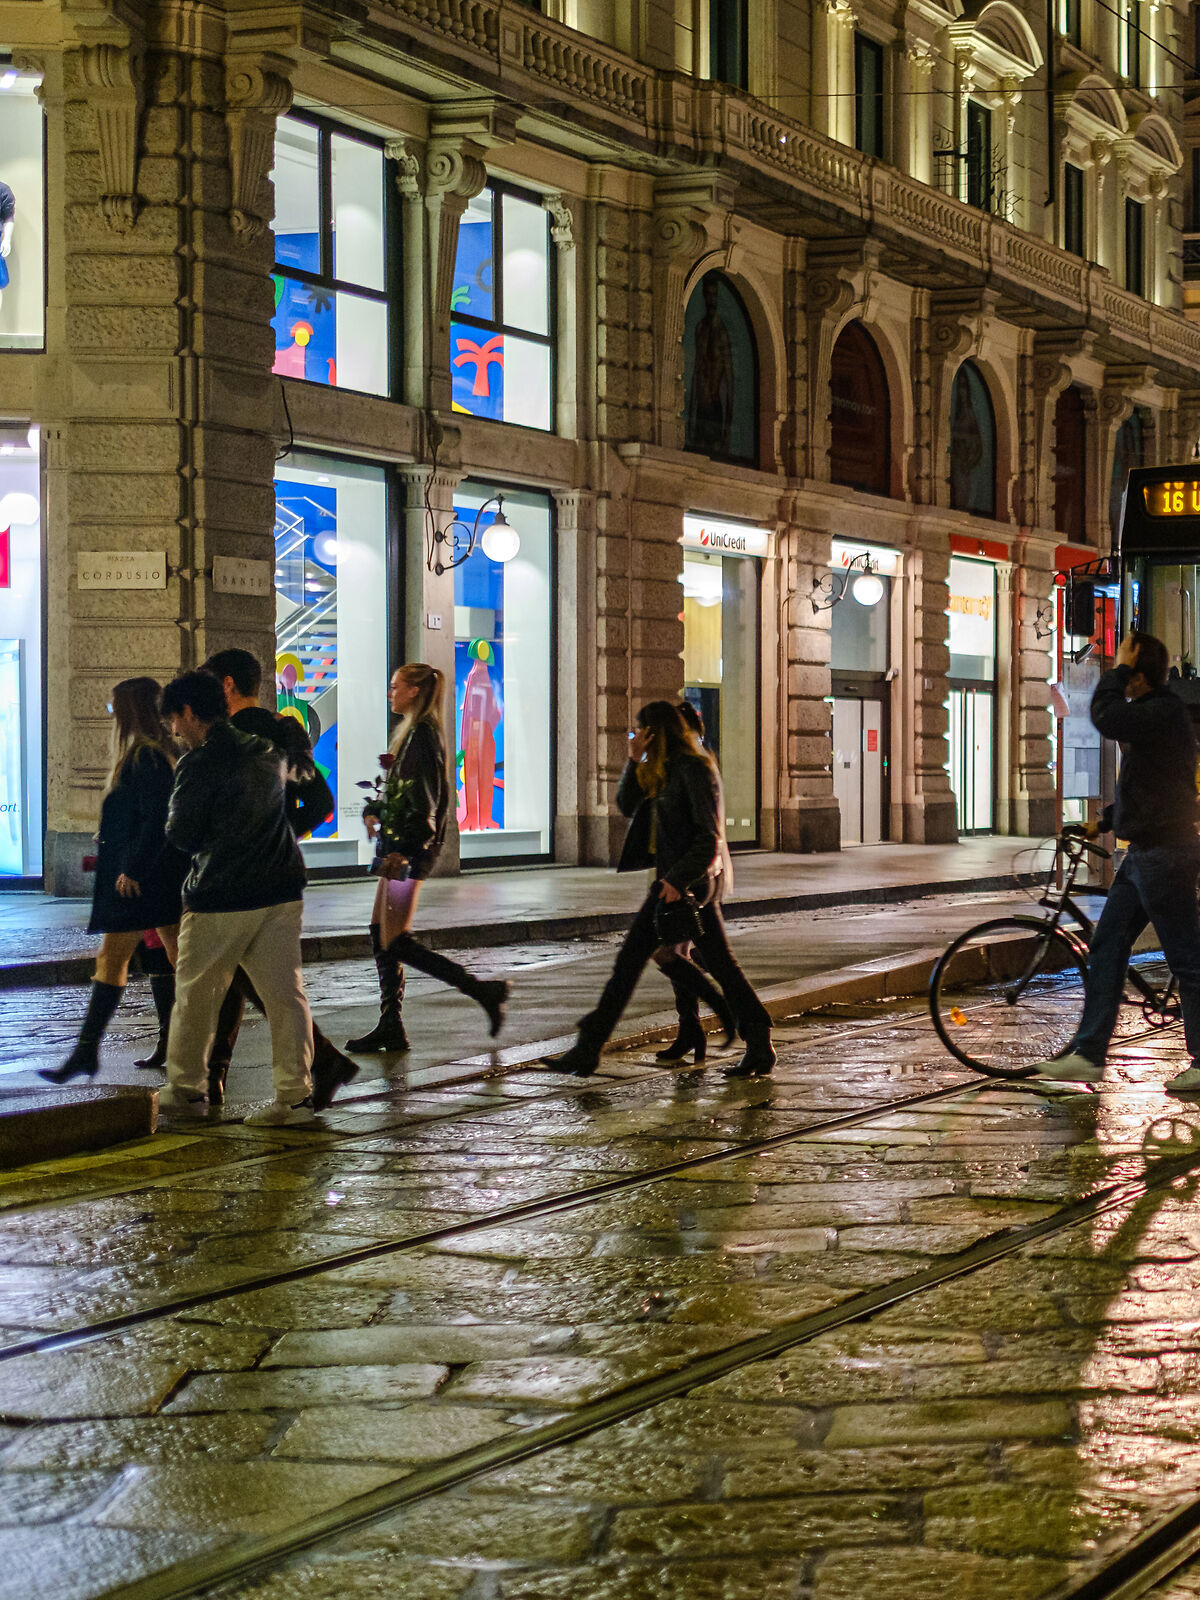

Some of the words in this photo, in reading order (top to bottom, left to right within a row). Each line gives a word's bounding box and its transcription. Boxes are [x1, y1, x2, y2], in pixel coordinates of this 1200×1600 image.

[1163, 491, 1184, 512] 16
[710, 531, 746, 550] UniCredit
[107, 555, 135, 563] PIAZZA
[82, 571, 160, 580] CORDUSIO
[222, 576, 263, 588] DANTE
